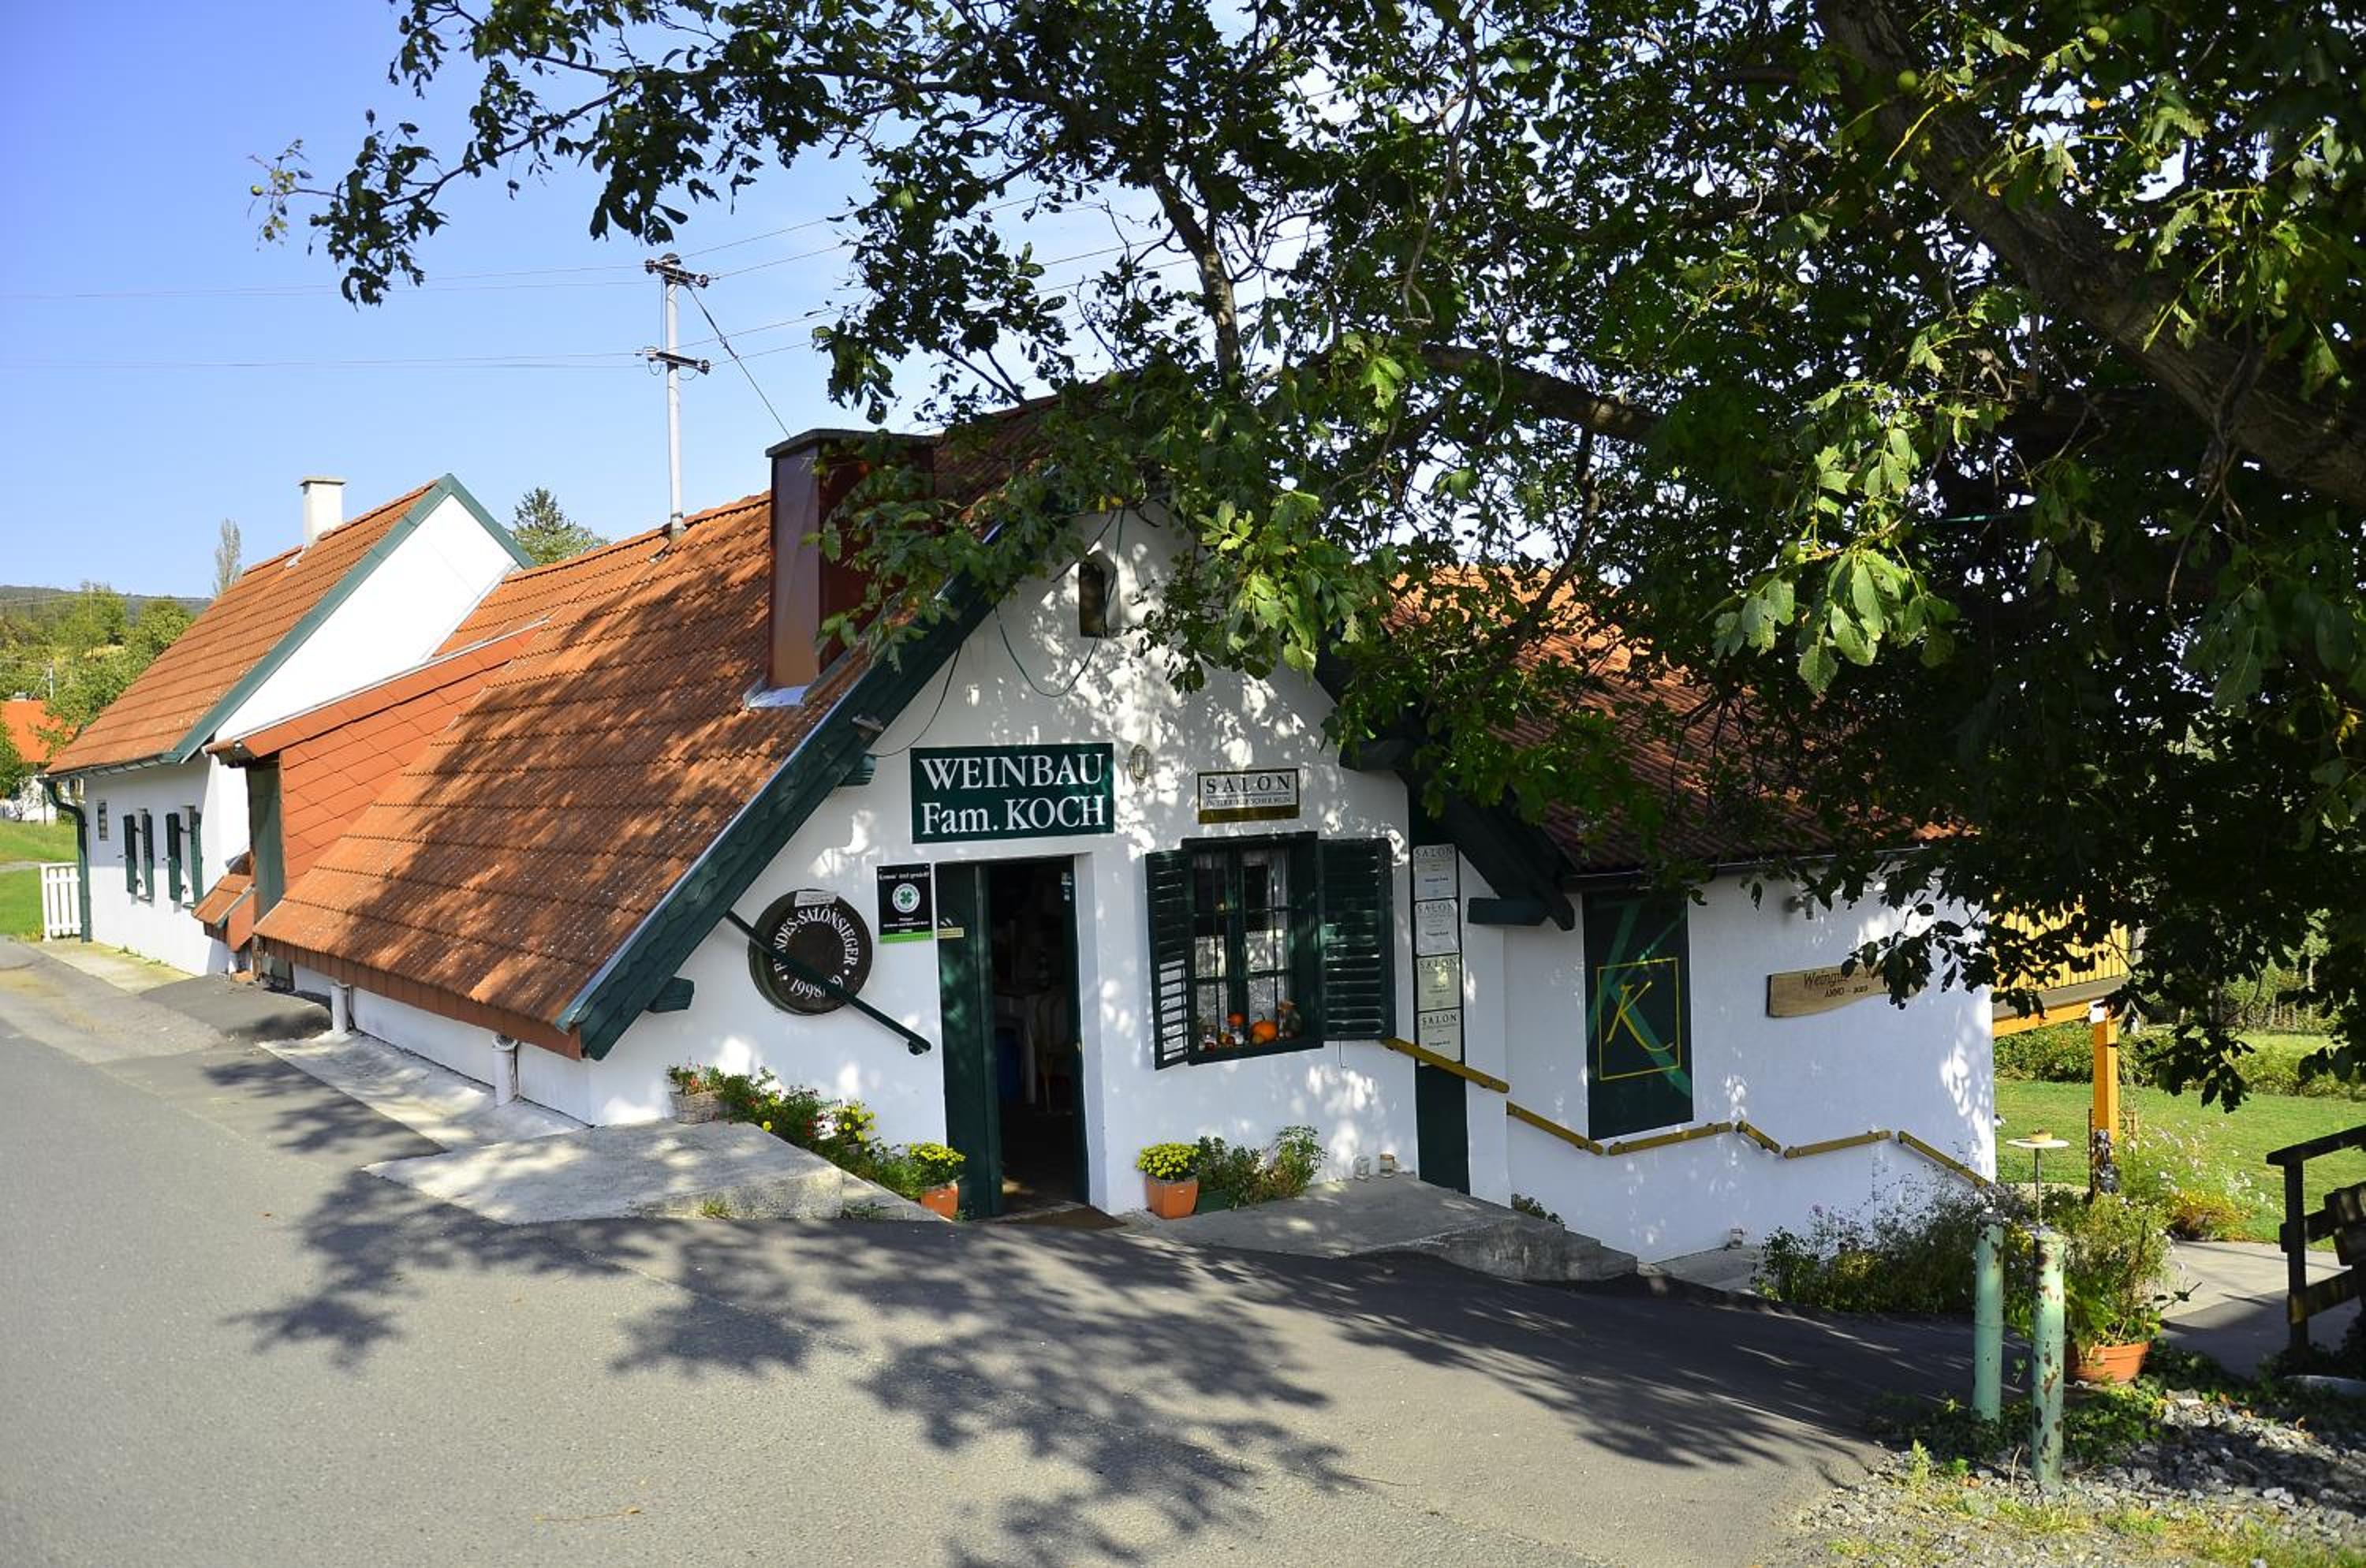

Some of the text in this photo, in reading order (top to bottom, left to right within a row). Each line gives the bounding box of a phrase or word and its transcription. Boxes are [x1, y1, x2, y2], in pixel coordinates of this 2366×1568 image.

[920, 753, 1105, 790] WEINBAU
[1206, 775, 1290, 794] SALON
[921, 794, 1106, 835] Fam. KOCH
[1415, 846, 1455, 859] SALON
[1421, 1013, 1457, 1025] SALON
[1605, 980, 1674, 1053] K
